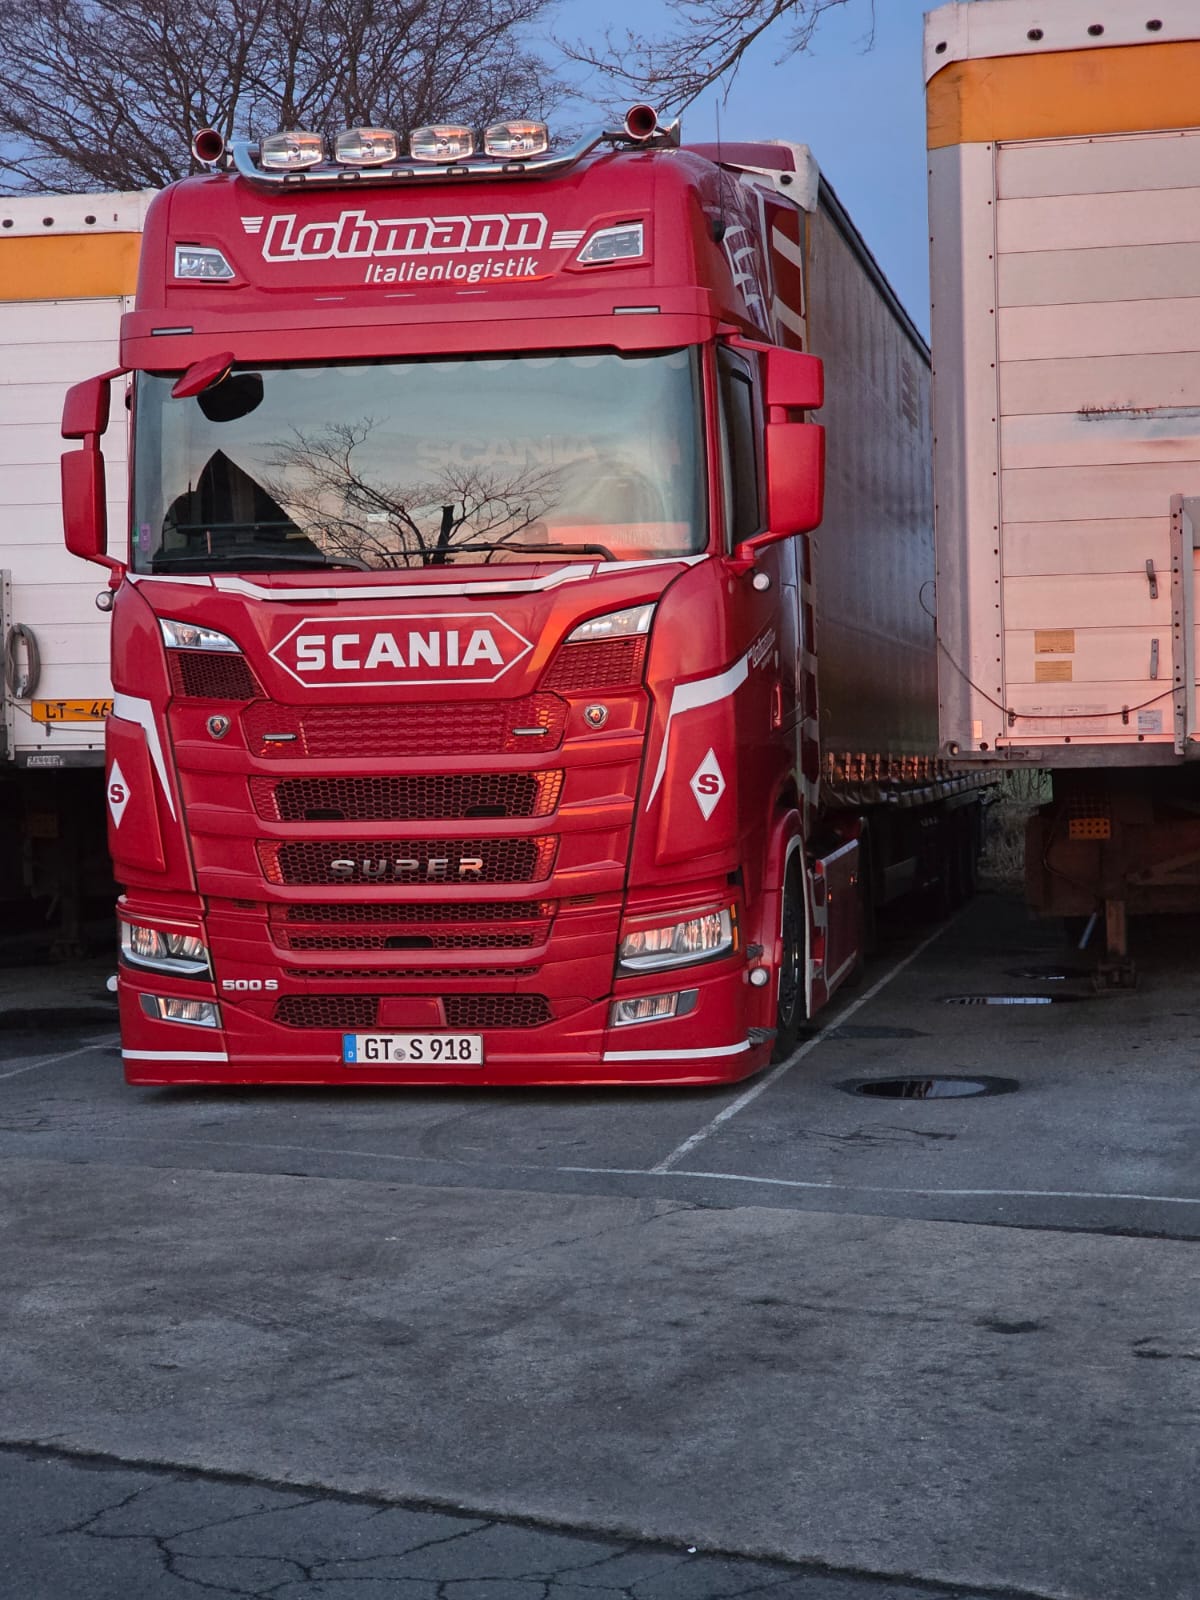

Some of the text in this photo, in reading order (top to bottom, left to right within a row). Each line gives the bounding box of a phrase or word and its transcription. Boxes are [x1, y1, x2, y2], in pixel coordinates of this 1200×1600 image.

[262, 210, 548, 263] Lohmann
[364, 257, 538, 284] Italienlogistik
[296, 629, 505, 671] SCANIA
[110, 783, 125, 804] S
[698, 773, 720, 795] S
[330, 857, 484, 877] SUPER
[222, 979, 279, 991] 500 S
[365, 1038, 393, 1060] GT
[409, 1038, 423, 1061] S
[430, 1038, 472, 1060] 918
